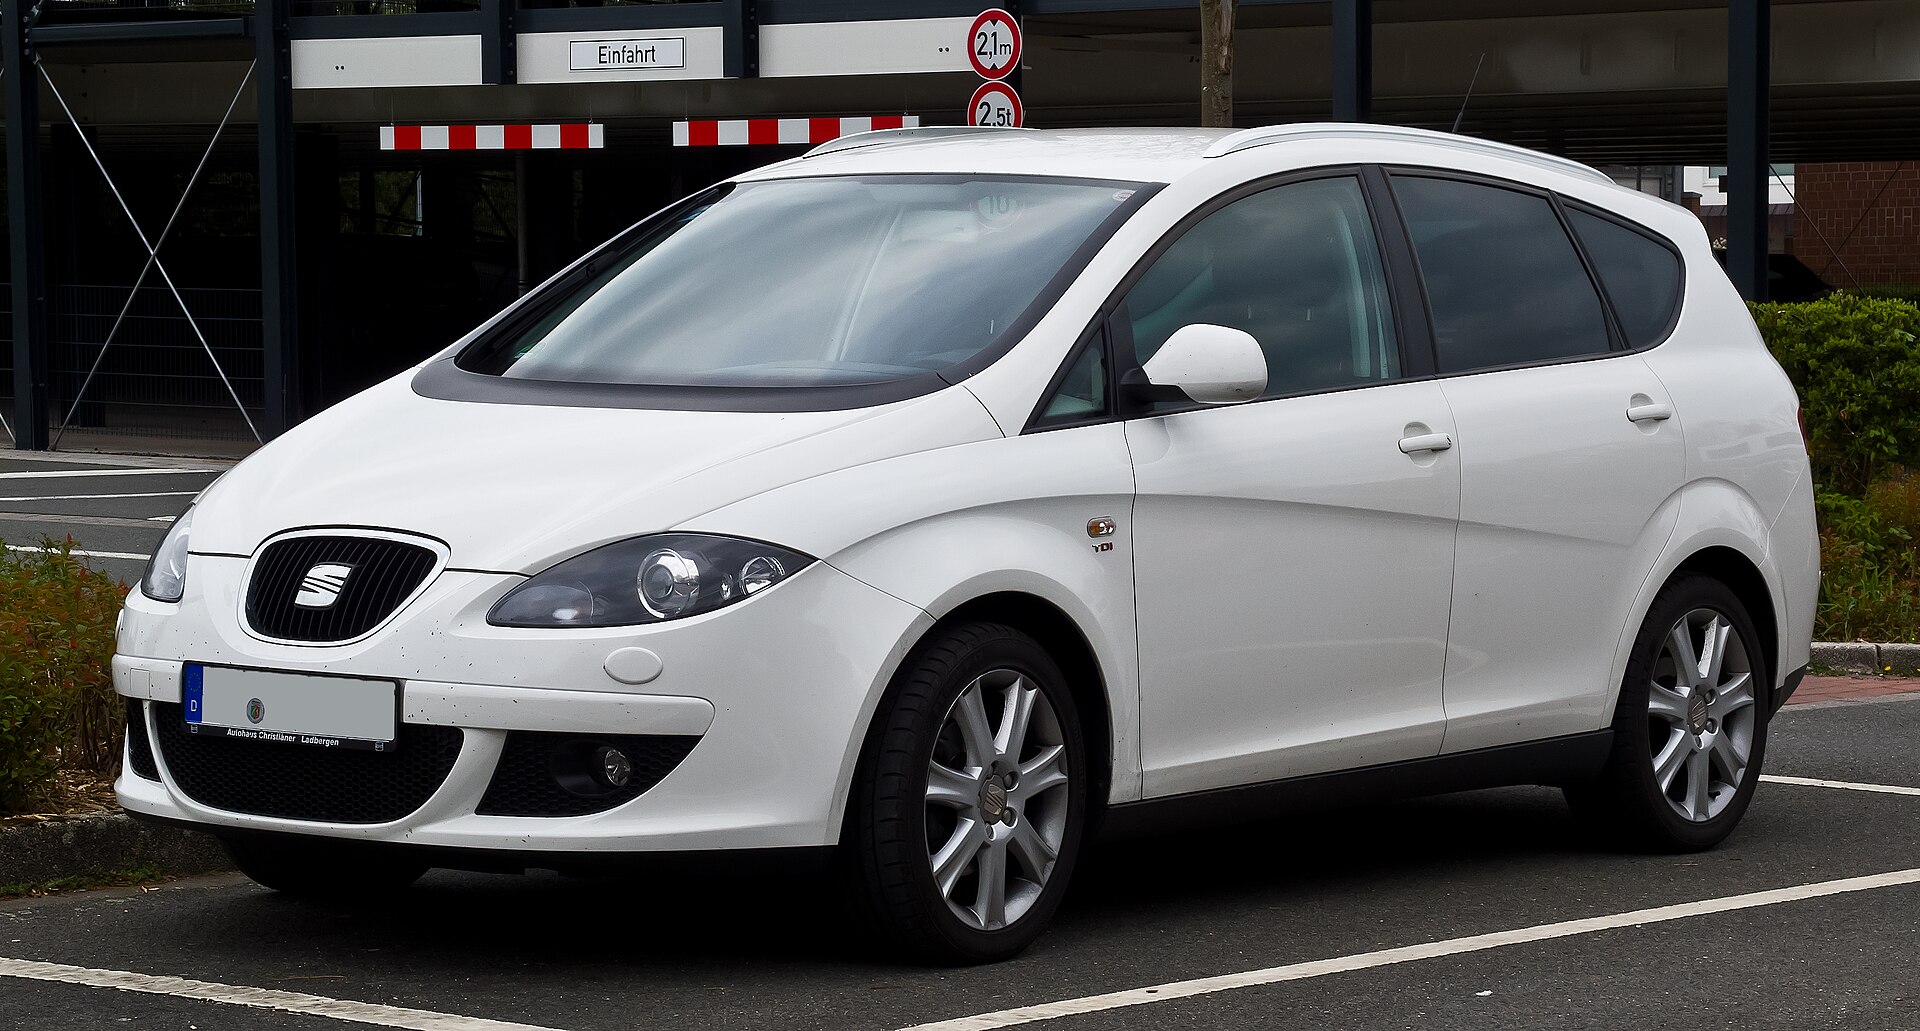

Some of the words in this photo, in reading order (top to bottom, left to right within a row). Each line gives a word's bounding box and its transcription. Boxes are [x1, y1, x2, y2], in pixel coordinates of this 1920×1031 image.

[598, 44, 656, 64] Einfahrt
[976, 31, 1012, 60] 2,1m
[1091, 542, 1113, 553] TDI
[190, 700, 198, 712] D
[226, 728, 257, 739] Autohaus
[301, 736, 339, 747] Ladbergen
